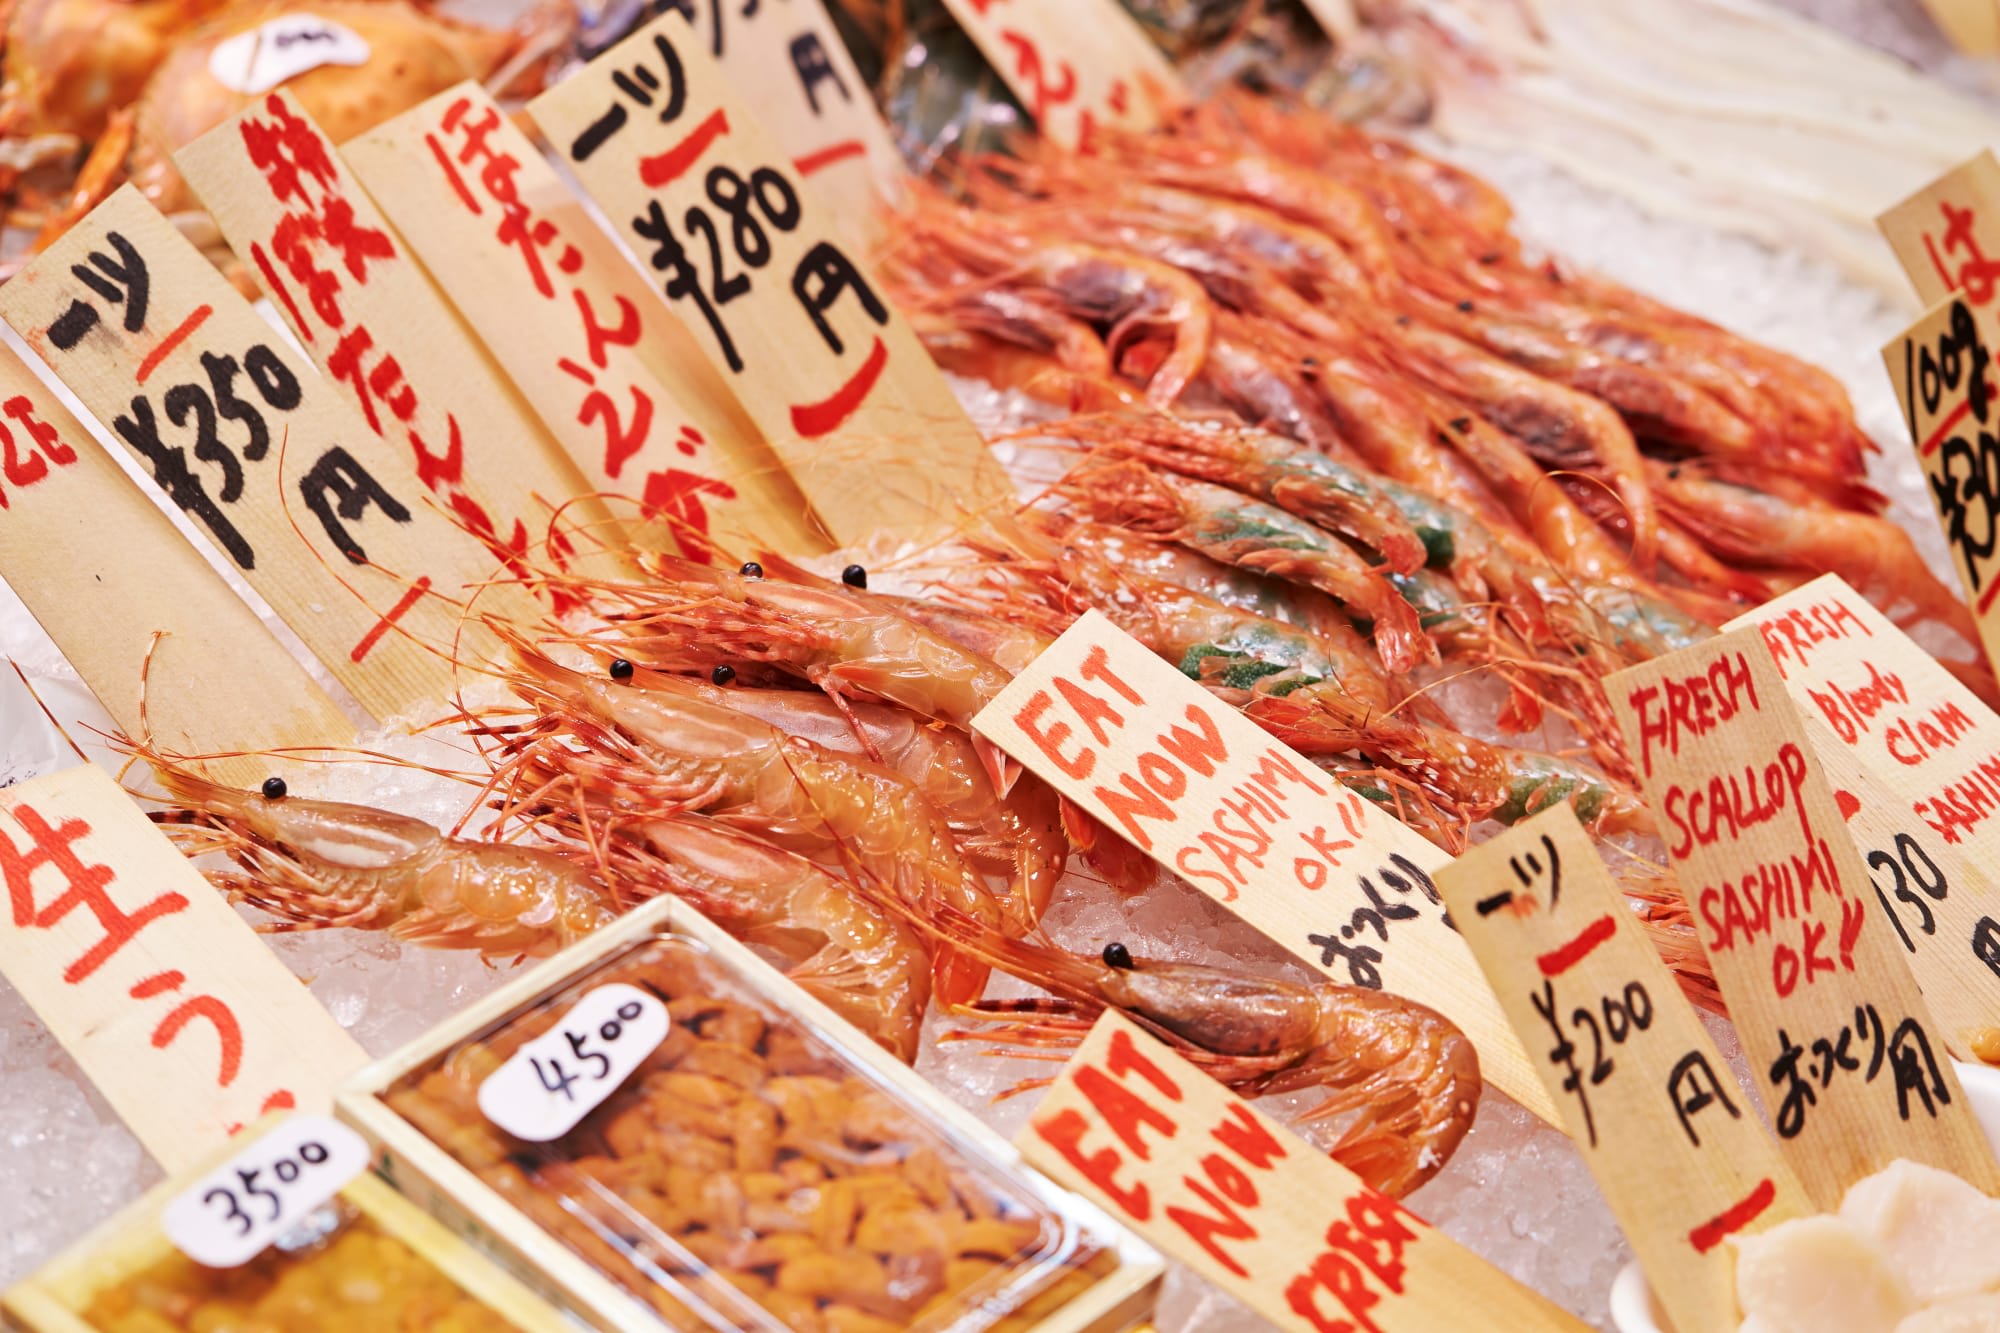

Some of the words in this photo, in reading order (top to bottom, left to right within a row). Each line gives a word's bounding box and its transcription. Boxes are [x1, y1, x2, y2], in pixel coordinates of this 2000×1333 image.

[632, 166, 801, 373] ¥280
[791, 242, 888, 354] 円
[113, 344, 302, 569] ¥350
[299, 446, 411, 565] 円
[1760, 597, 1872, 680] FRESH
[1012, 644, 1146, 780] EAT
[1093, 704, 1229, 850] NOW
[1630, 652, 1759, 778] FRESH
[1664, 743, 1806, 860] SCALLOP
[1308, 852, 1458, 990] おつくり
[1700, 838, 1842, 952] SASHIMI
[0, 803, 296, 1137] 生う
[530, 1001, 642, 1101] 4500
[1531, 979, 1653, 1148] ¥200
[1667, 1050, 1741, 1147] 円
[203, 1141, 329, 1236] 3500
[1031, 1030, 1183, 1222] EAT
[1165, 1103, 1288, 1280] NOW
